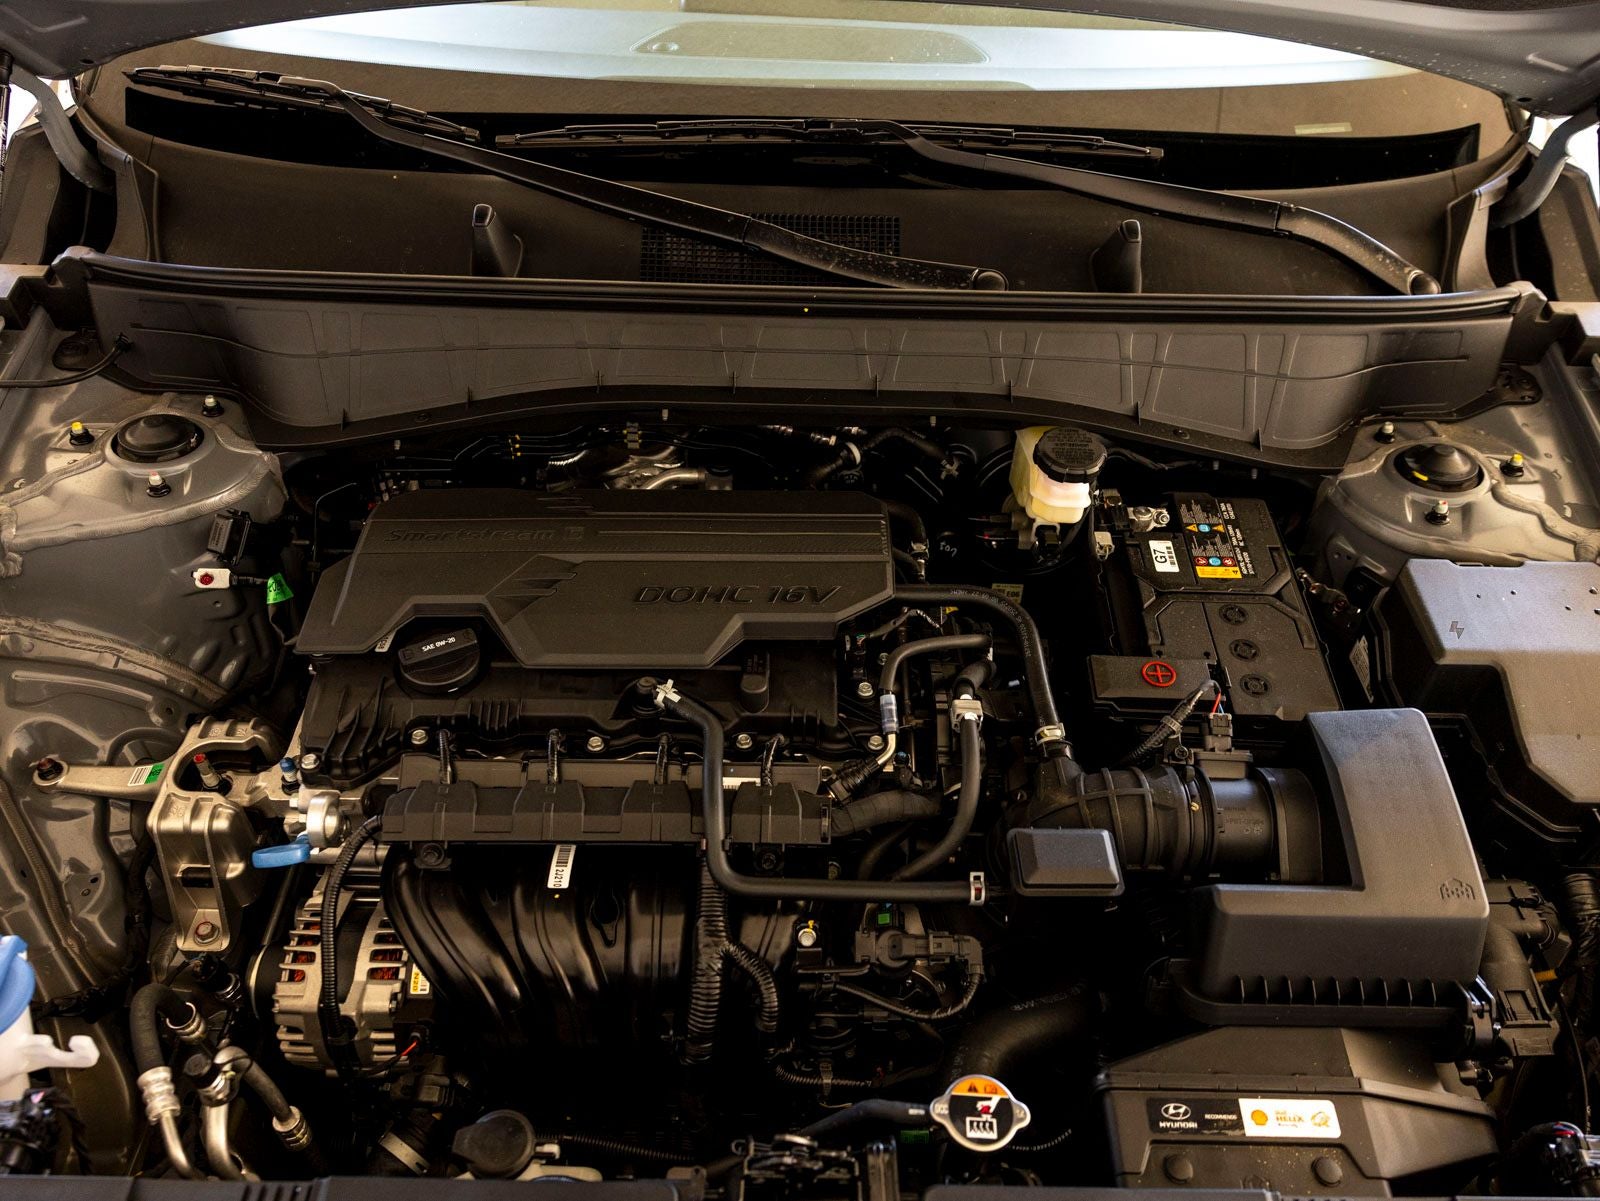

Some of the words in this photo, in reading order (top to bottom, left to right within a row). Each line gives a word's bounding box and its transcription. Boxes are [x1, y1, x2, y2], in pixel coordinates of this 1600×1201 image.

[1153, 549, 1167, 563] G7
[634, 585, 760, 604] DOHC
[768, 585, 842, 605] 16V
[435, 637, 456, 647] 0W-20
[1159, 1121, 1198, 1129] HYUNDAI
